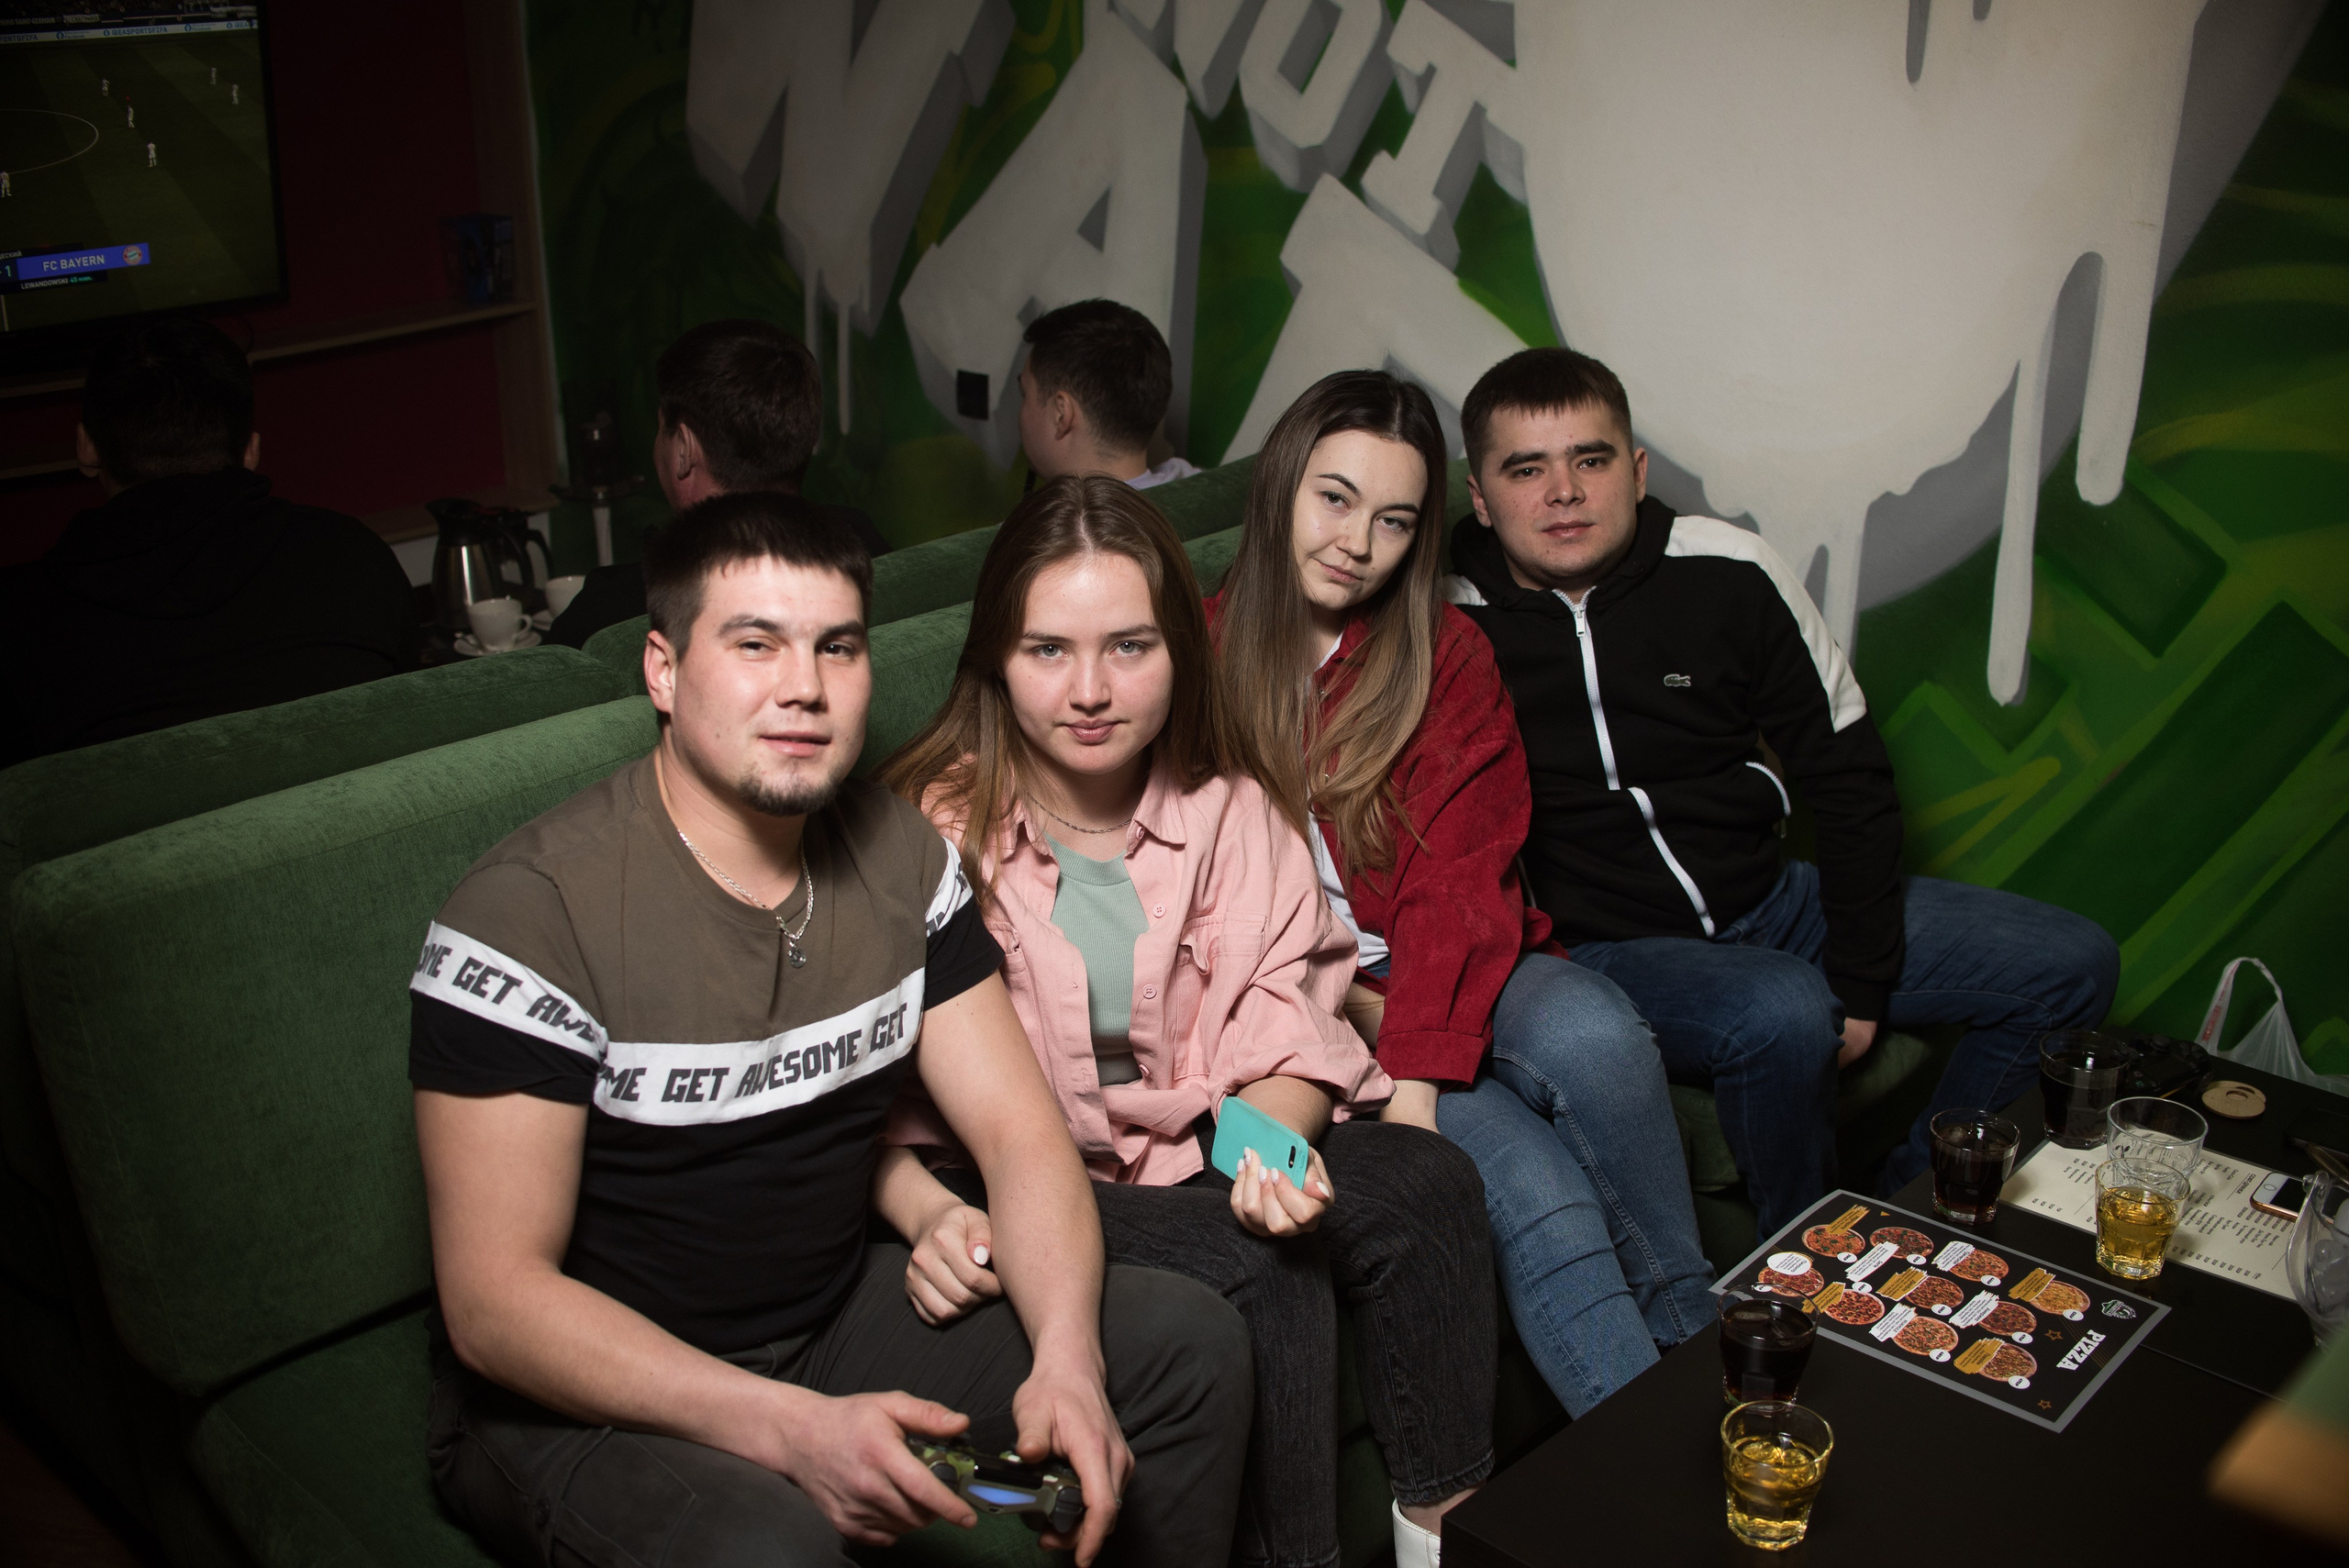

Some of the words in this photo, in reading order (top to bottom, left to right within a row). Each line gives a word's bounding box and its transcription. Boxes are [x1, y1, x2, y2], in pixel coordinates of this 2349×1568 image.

[20, 277, 69, 290] LEWANDOWSKI
[43, 261, 57, 272] FC
[60, 255, 105, 269] BAYERN
[451, 955, 524, 1006] GET
[599, 1066, 648, 1103] ME
[661, 1066, 731, 1105] GET
[734, 1028, 863, 1099] AWESOME
[869, 1002, 908, 1053] GET
[2055, 1329, 2107, 1372] PIZZA
